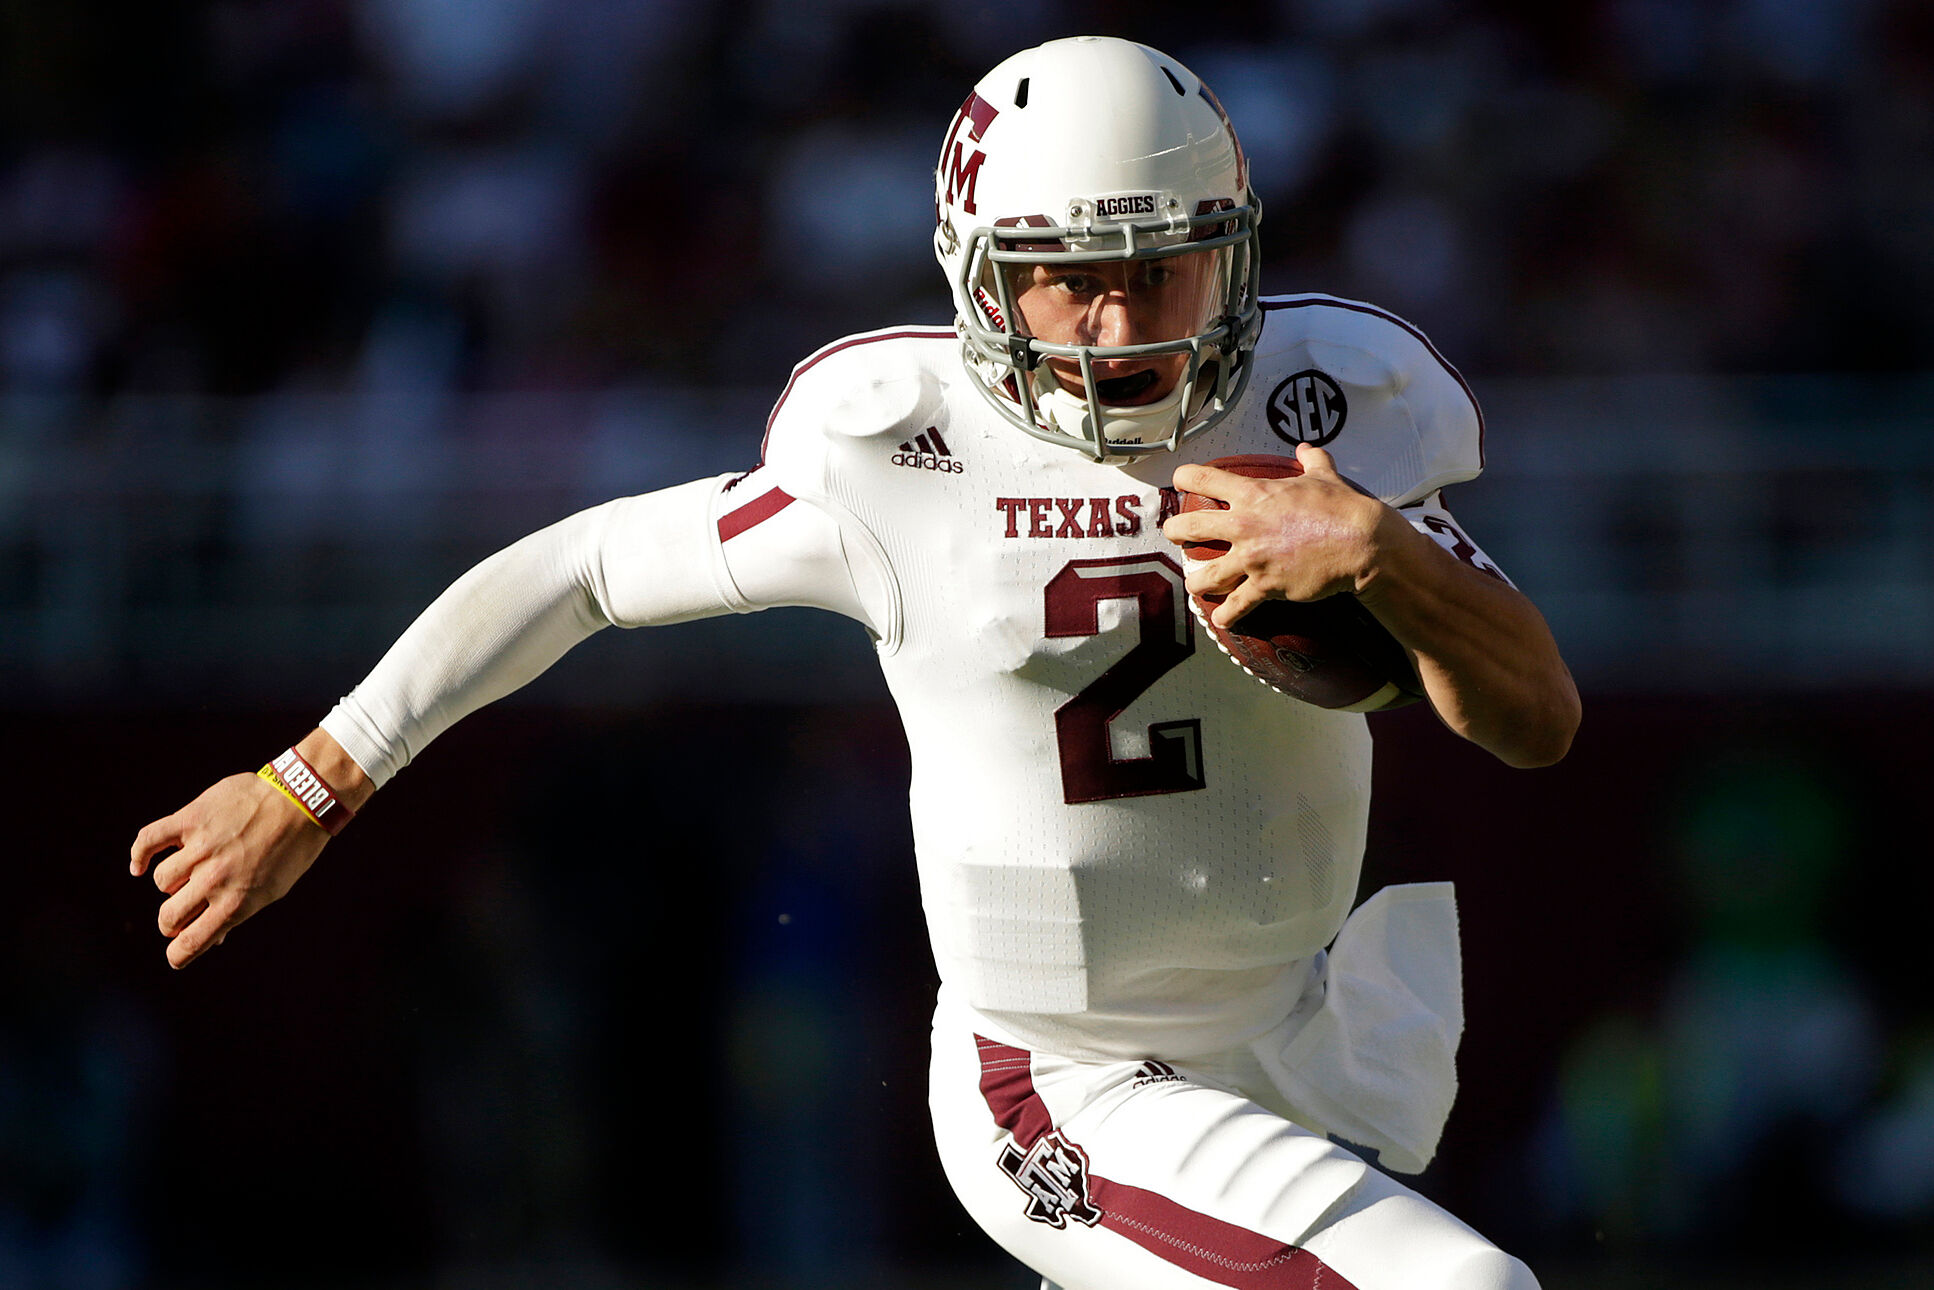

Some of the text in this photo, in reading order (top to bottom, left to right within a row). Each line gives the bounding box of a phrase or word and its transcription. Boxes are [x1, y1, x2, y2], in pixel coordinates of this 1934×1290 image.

[1096, 195, 1155, 217] AGGIES
[1273, 376, 1340, 442] SEC
[890, 450, 964, 474] adidas
[995, 494, 1142, 539] TEXAS
[1044, 551, 1207, 805] 2
[283, 760, 330, 812] BLEED
